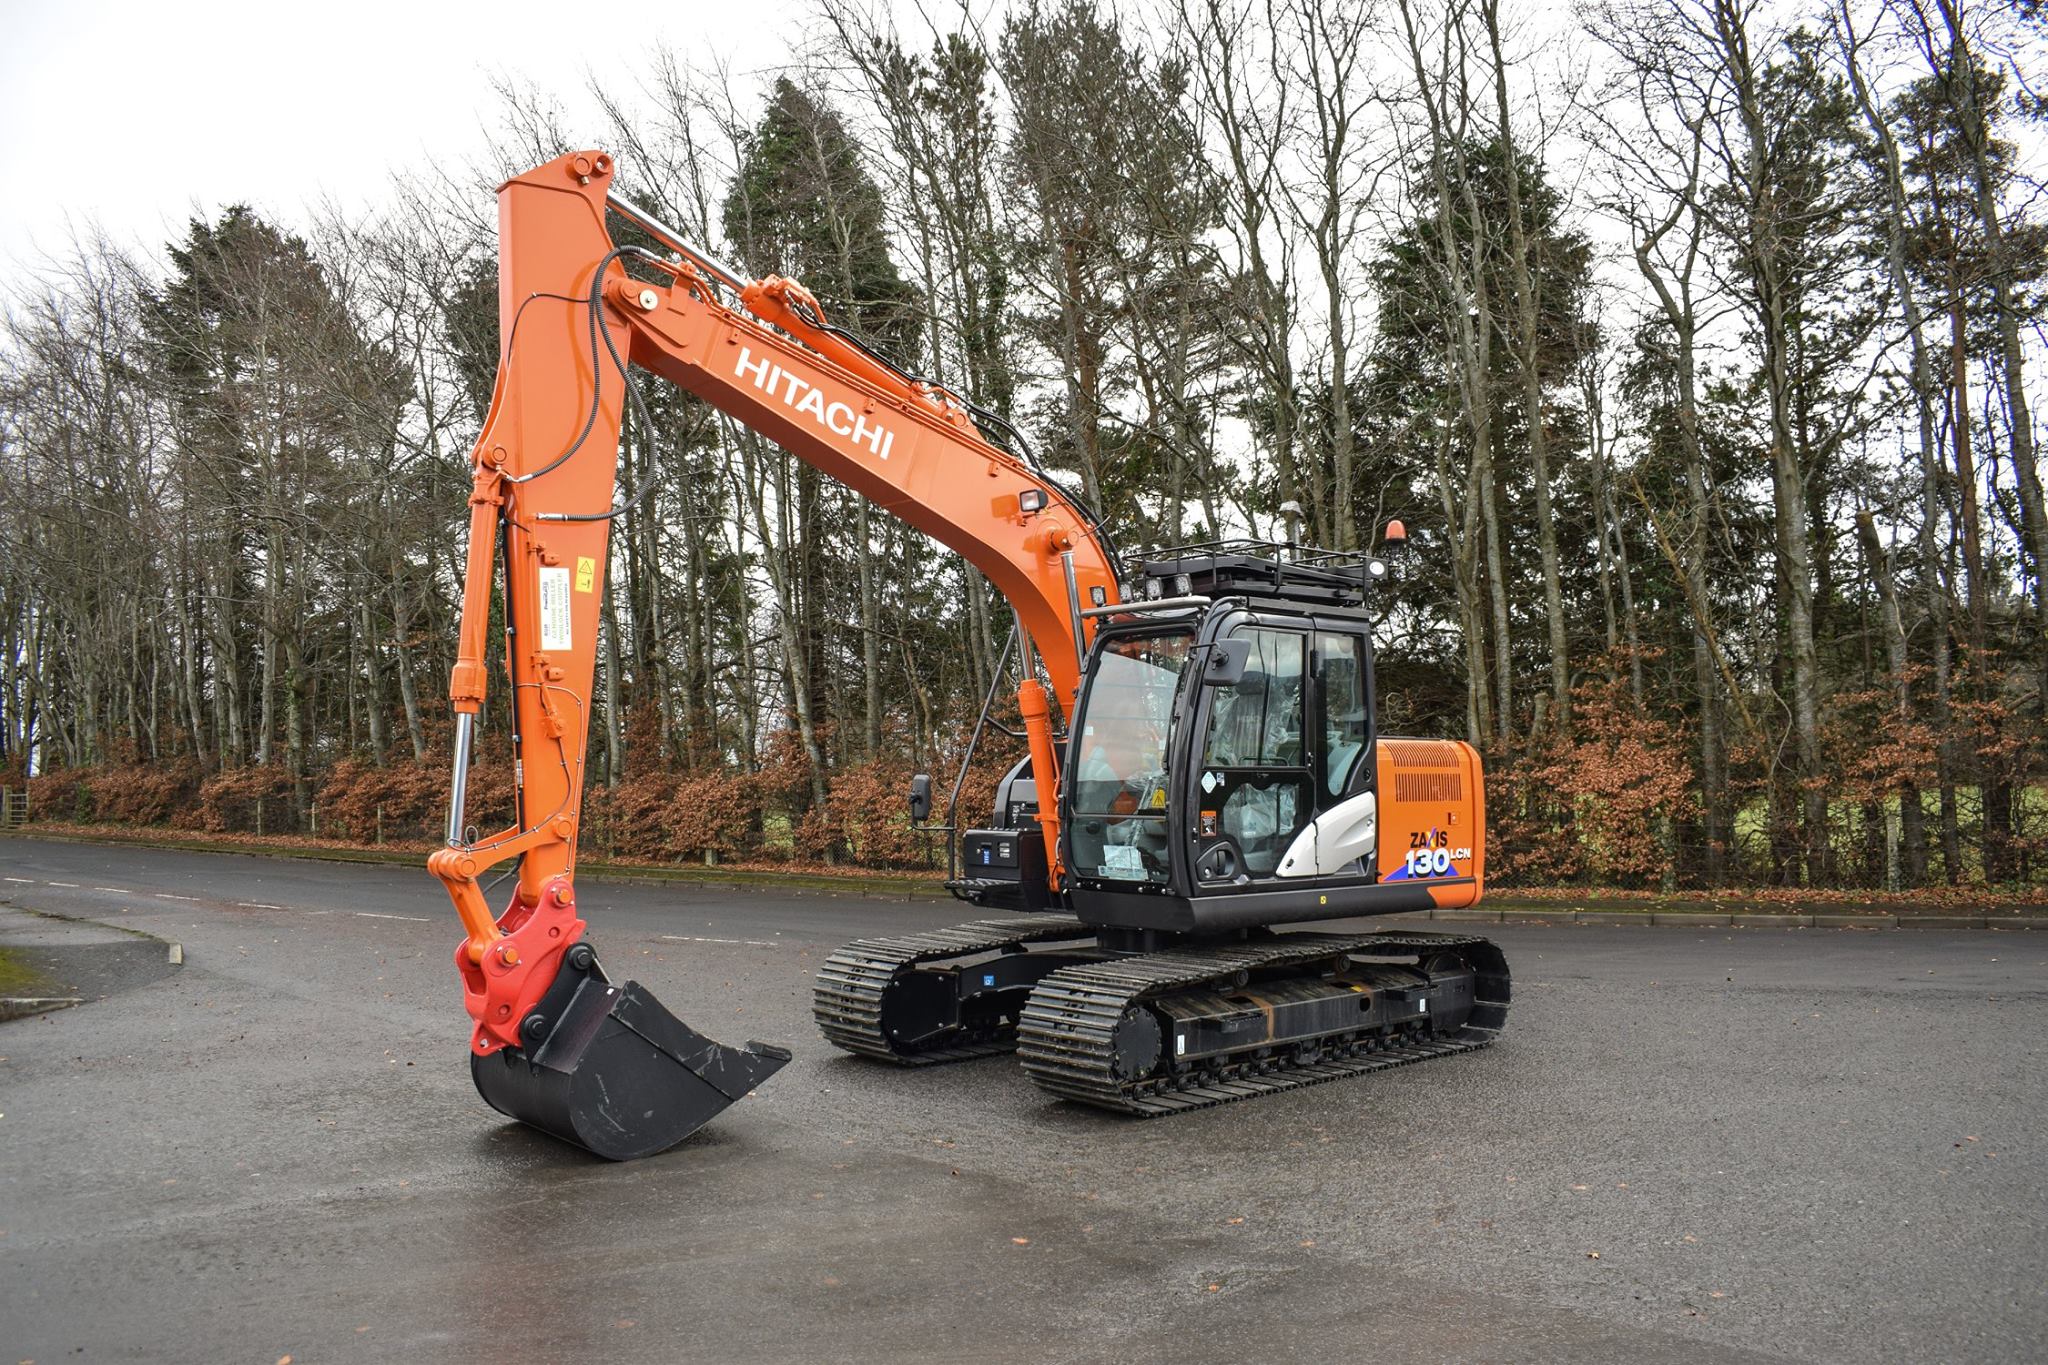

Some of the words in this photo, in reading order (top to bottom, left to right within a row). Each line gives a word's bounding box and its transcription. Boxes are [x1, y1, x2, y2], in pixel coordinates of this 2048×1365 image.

[734, 346, 894, 460] HITACHI
[1410, 827, 1448, 849] ZAXIS
[1405, 848, 1451, 877] 130
